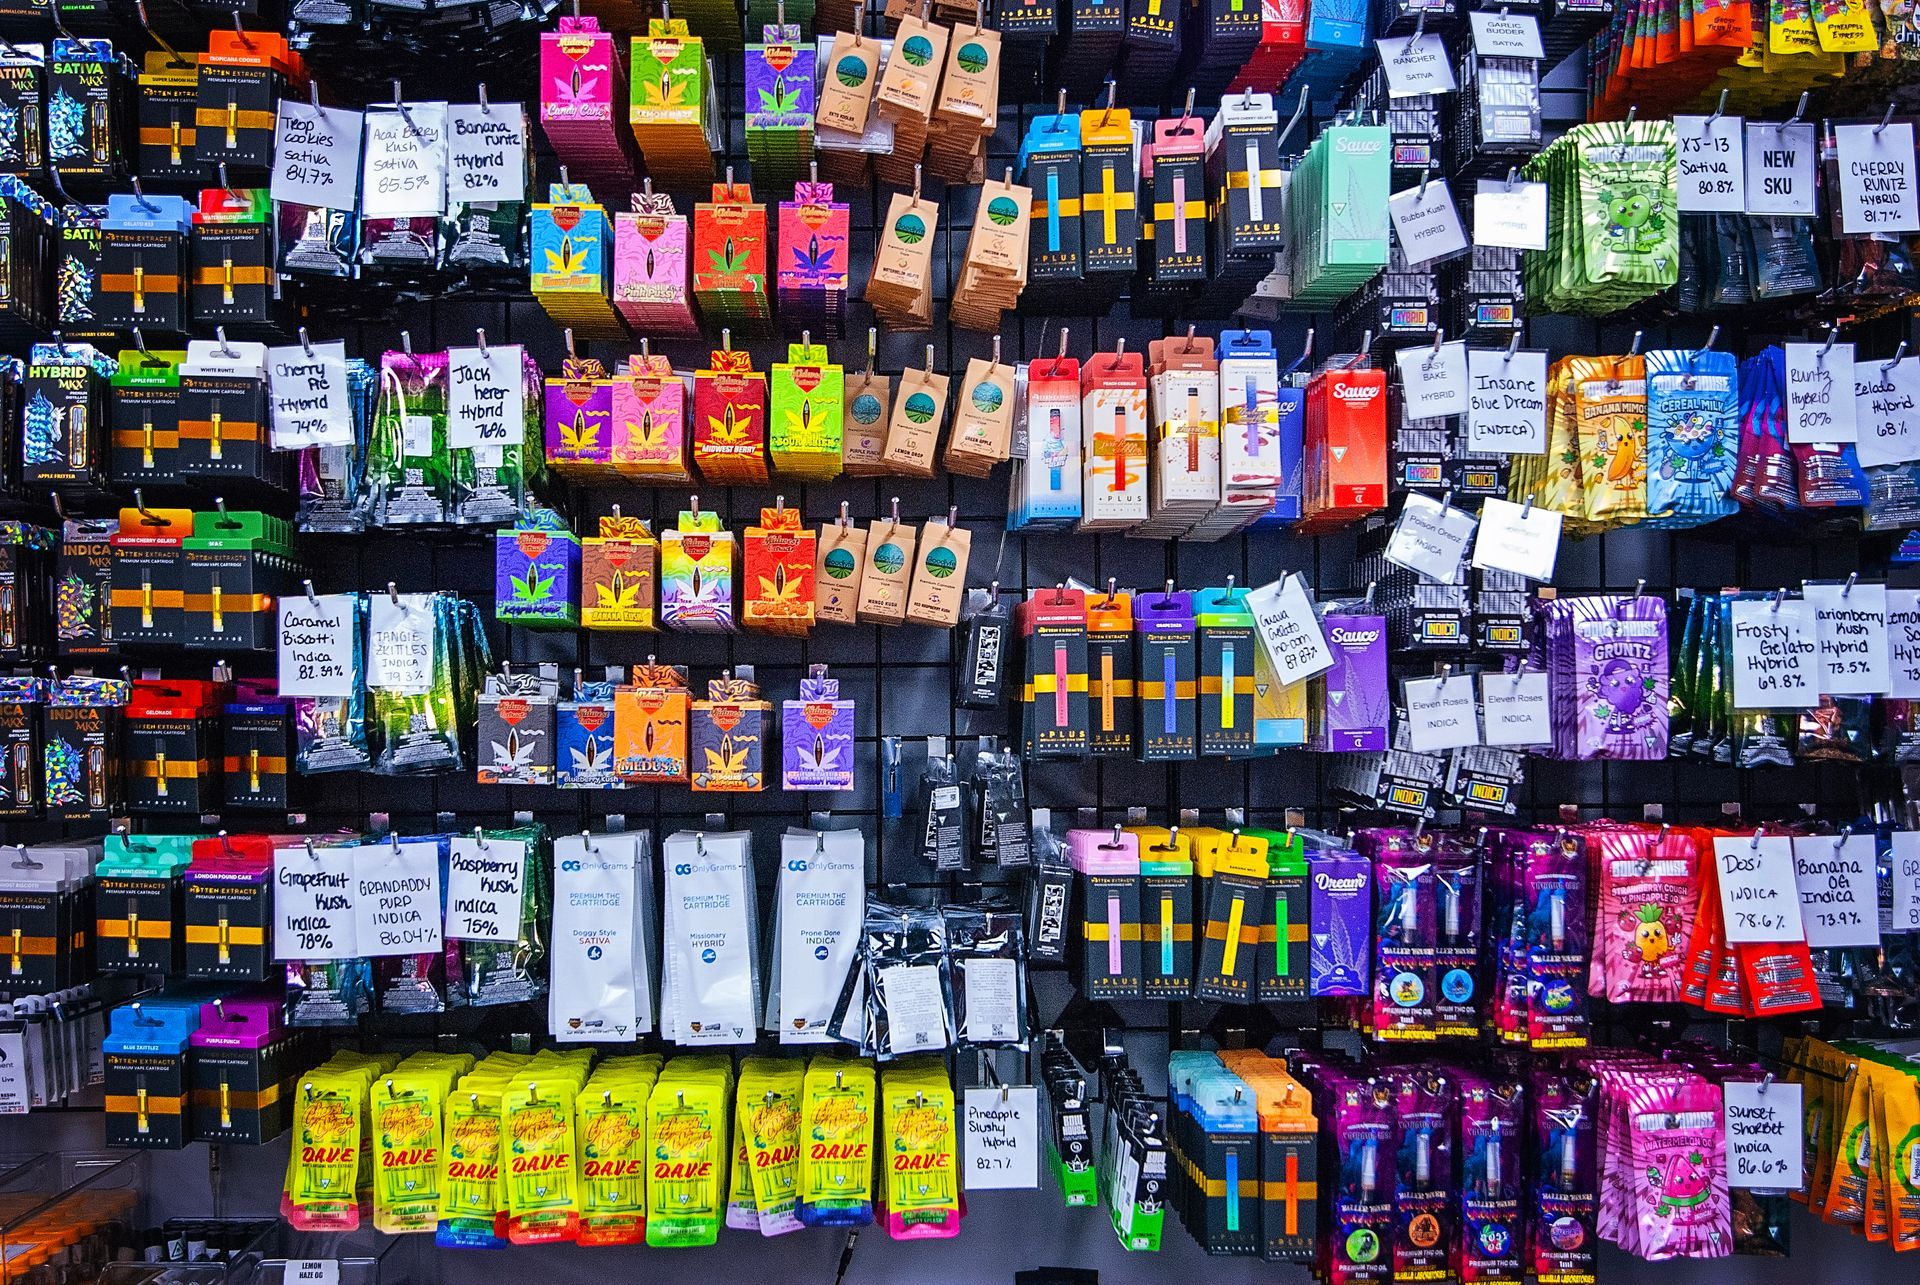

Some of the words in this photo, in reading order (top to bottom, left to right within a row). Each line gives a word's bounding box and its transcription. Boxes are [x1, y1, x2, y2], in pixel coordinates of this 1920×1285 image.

[1400, 48, 1424, 56] JELLY
[1393, 55, 1436, 65] RANCHER
[54, 63, 104, 74] SATIVA
[1406, 72, 1433, 80] SATIVA
[80, 75, 104, 85] MKX
[548, 105, 577, 117] Candy
[580, 105, 604, 117] Cane
[374, 128, 397, 140] Acai
[455, 120, 510, 135] Banana
[386, 141, 417, 152] Kush
[1335, 137, 1382, 153] Sauce
[1682, 137, 1729, 152] XJ-13
[454, 152, 503, 169] Hybrid
[1764, 150, 1795, 168] NEW
[1680, 160, 1728, 175] Sativa
[1852, 161, 1904, 176] CHERRY
[286, 167, 333, 184] 84.7%
[464, 174, 498, 188] 82%
[378, 176, 430, 192] 85.5%
[1699, 181, 1734, 195] 80.8%
[1764, 178, 1792, 195] SKU
[1865, 178, 1908, 192] RUNTZ
[1860, 194, 1900, 205] HYBRID
[1401, 211, 1425, 223] Bubba
[1426, 204, 1445, 215] Kush
[1865, 210, 1901, 223] 81.7%
[1414, 225, 1445, 240] HYBRID
[30, 366, 87, 378] HYBRID
[276, 363, 325, 379] Cherry
[1422, 362, 1445, 372] EASY
[453, 367, 491, 384] Jack
[1423, 371, 1447, 381] BAKE
[59, 379, 84, 390] MKX
[309, 379, 330, 391] Pie
[1333, 383, 1379, 398] Sauce
[1474, 376, 1536, 392] Insane
[1421, 390, 1455, 401] HYBRID
[1471, 395, 1499, 410] Blue
[1505, 395, 1543, 410] Dream
[279, 396, 328, 412] Hybrid
[1662, 399, 1698, 414] CEREAL
[1700, 399, 1725, 413] MILK
[1872, 395, 1914, 416] Hybrid
[460, 404, 503, 420] Hybrid
[291, 419, 327, 434] 74%
[1800, 412, 1831, 428] 80%
[475, 424, 507, 438] 76%
[1474, 420, 1536, 440] (INDICA)
[1877, 421, 1907, 437] 68%
[702, 445, 732, 454] MIDWEST
[734, 445, 756, 454] BERRY
[1410, 515, 1436, 532] Poison
[284, 611, 340, 628] Caramel
[1331, 628, 1379, 643] Sauce
[1490, 629, 1517, 641] INDICA
[1736, 622, 1789, 639] Frosty
[1836, 623, 1868, 635] Kush
[282, 631, 335, 646] Biscotti
[1593, 643, 1650, 660] GRUNTZ
[1760, 640, 1814, 656] Gelato
[1821, 640, 1868, 658] Hybrid
[293, 651, 332, 662] Indica
[1748, 656, 1799, 673] Hybrid
[1828, 661, 1870, 674] 73.5%
[298, 665, 343, 680] 82.39%
[1758, 675, 1805, 690] 69.8%
[1413, 698, 1441, 710] Eleven
[1443, 696, 1469, 707] Roses
[1488, 695, 1516, 703] Eleven
[1518, 694, 1543, 703] Roses
[50, 709, 99, 720] INDICA
[1501, 714, 1532, 724] INDICA
[1427, 718, 1458, 728] INDICA
[620, 760, 678, 771] MEDUSA
[1392, 788, 1423, 806] INDICA
[1472, 783, 1503, 801] INDICA
[452, 853, 518, 880] Raspberry
[1722, 854, 1763, 873] Dosi
[1798, 859, 1863, 876] Banana
[360, 878, 431, 896] GRANDADDY
[481, 877, 518, 894] Kush
[1315, 873, 1365, 891] Dream
[1828, 875, 1850, 889] OG
[1611, 884, 1663, 896] STRAWBERRY
[1664, 886, 1688, 896] COUGH
[1730, 889, 1778, 901] INDICA
[1802, 890, 1854, 904] Indica
[315, 894, 351, 910] Kush
[380, 896, 411, 909] PURP
[684, 901, 730, 909] CARTRIDGE
[1627, 894, 1667, 903] PINEAPPLE
[455, 899, 498, 914] Indica
[288, 916, 330, 931] Indica
[373, 911, 421, 925] INDICA
[1735, 912, 1785, 929] 78.6%
[1817, 913, 1861, 926] 73.9%
[463, 918, 498, 936] 75%
[599, 929, 616, 937] Style
[296, 934, 333, 949] 78%
[380, 929, 437, 946] 86.04%
[690, 932, 726, 941] Missionary
[969, 1106, 1020, 1122] Pineapple
[1729, 1105, 1776, 1121] Sunset
[969, 1121, 1006, 1136] Slushy
[983, 1136, 1016, 1149] Hybrid
[1644, 1136, 1700, 1151] WATERMELON
[1738, 1157, 1788, 1174] 86.6%
[302, 1262, 322, 1270] LEMON
